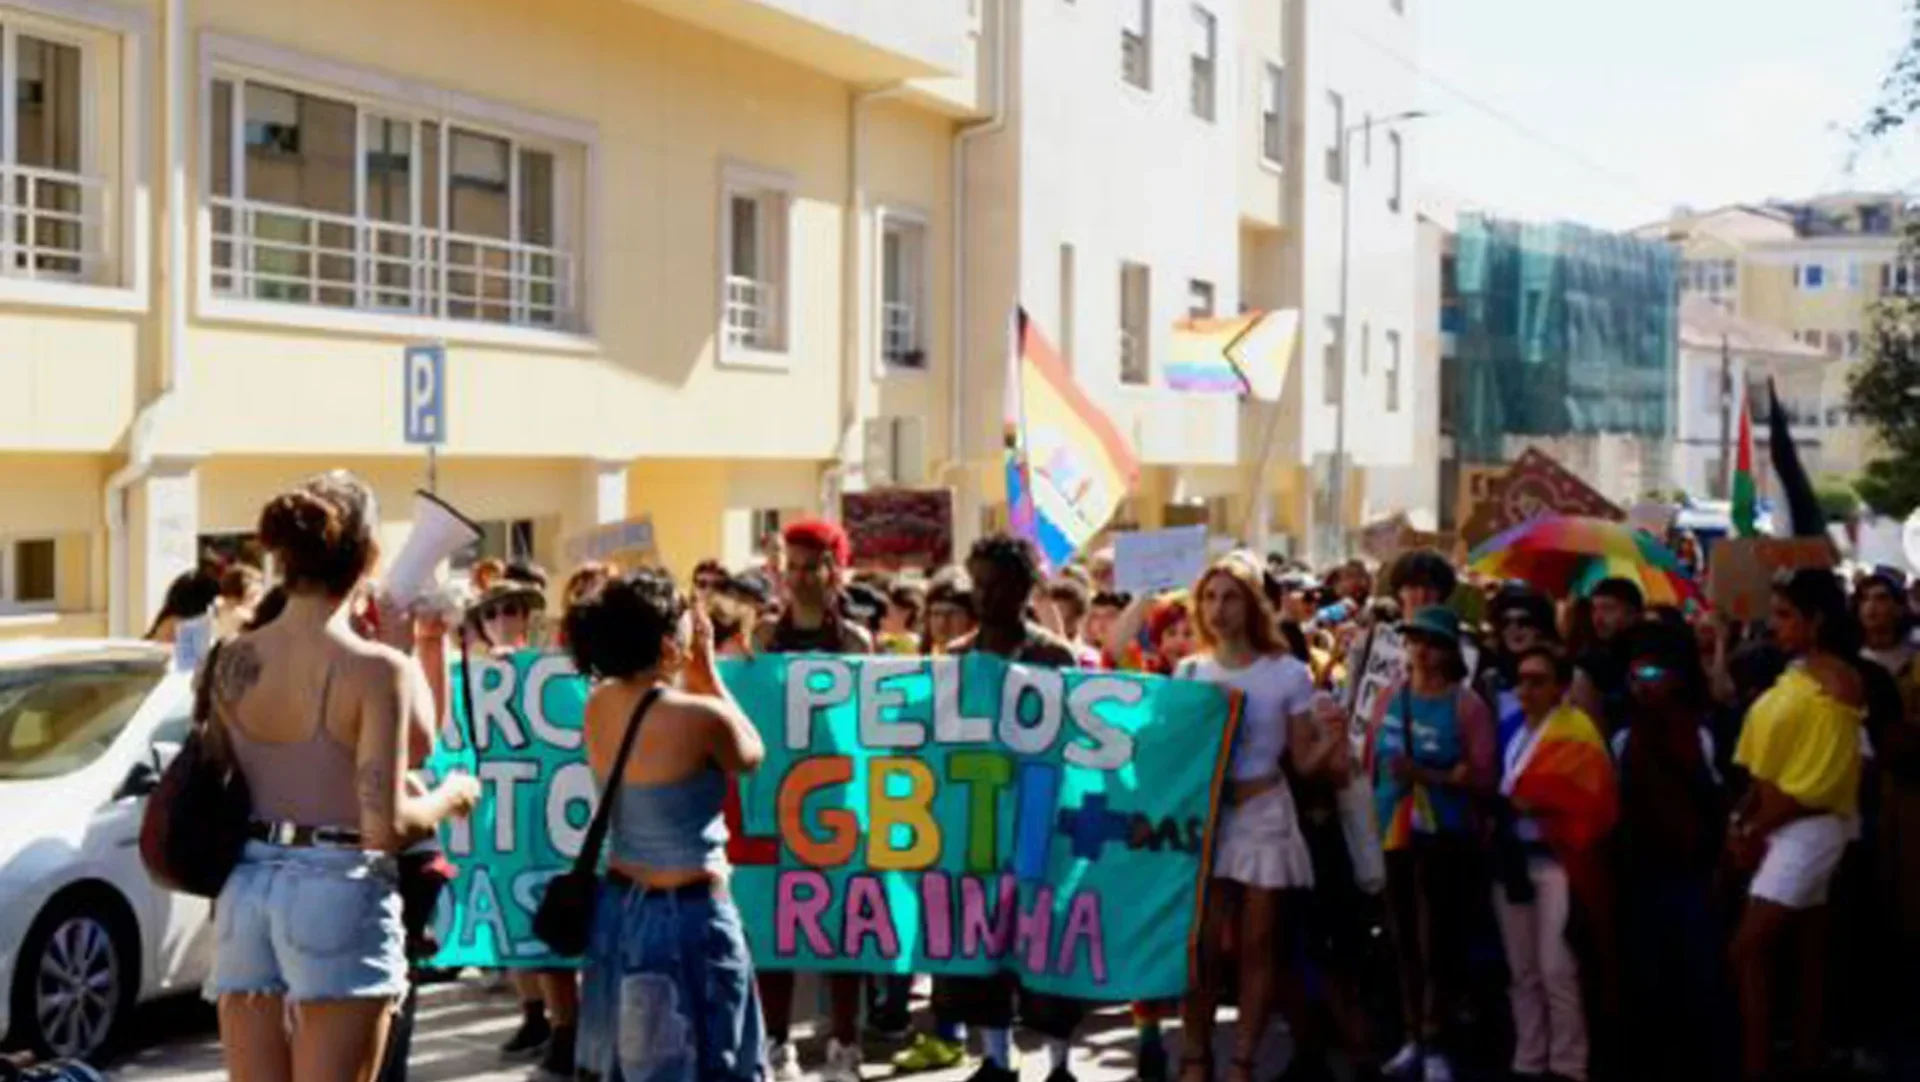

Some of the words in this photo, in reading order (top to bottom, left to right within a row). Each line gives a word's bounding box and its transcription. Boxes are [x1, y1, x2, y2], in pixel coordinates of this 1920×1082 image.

[411, 353, 435, 436] P
[785, 657, 1142, 769] PELOS
[776, 871, 1108, 985] RAINHA
